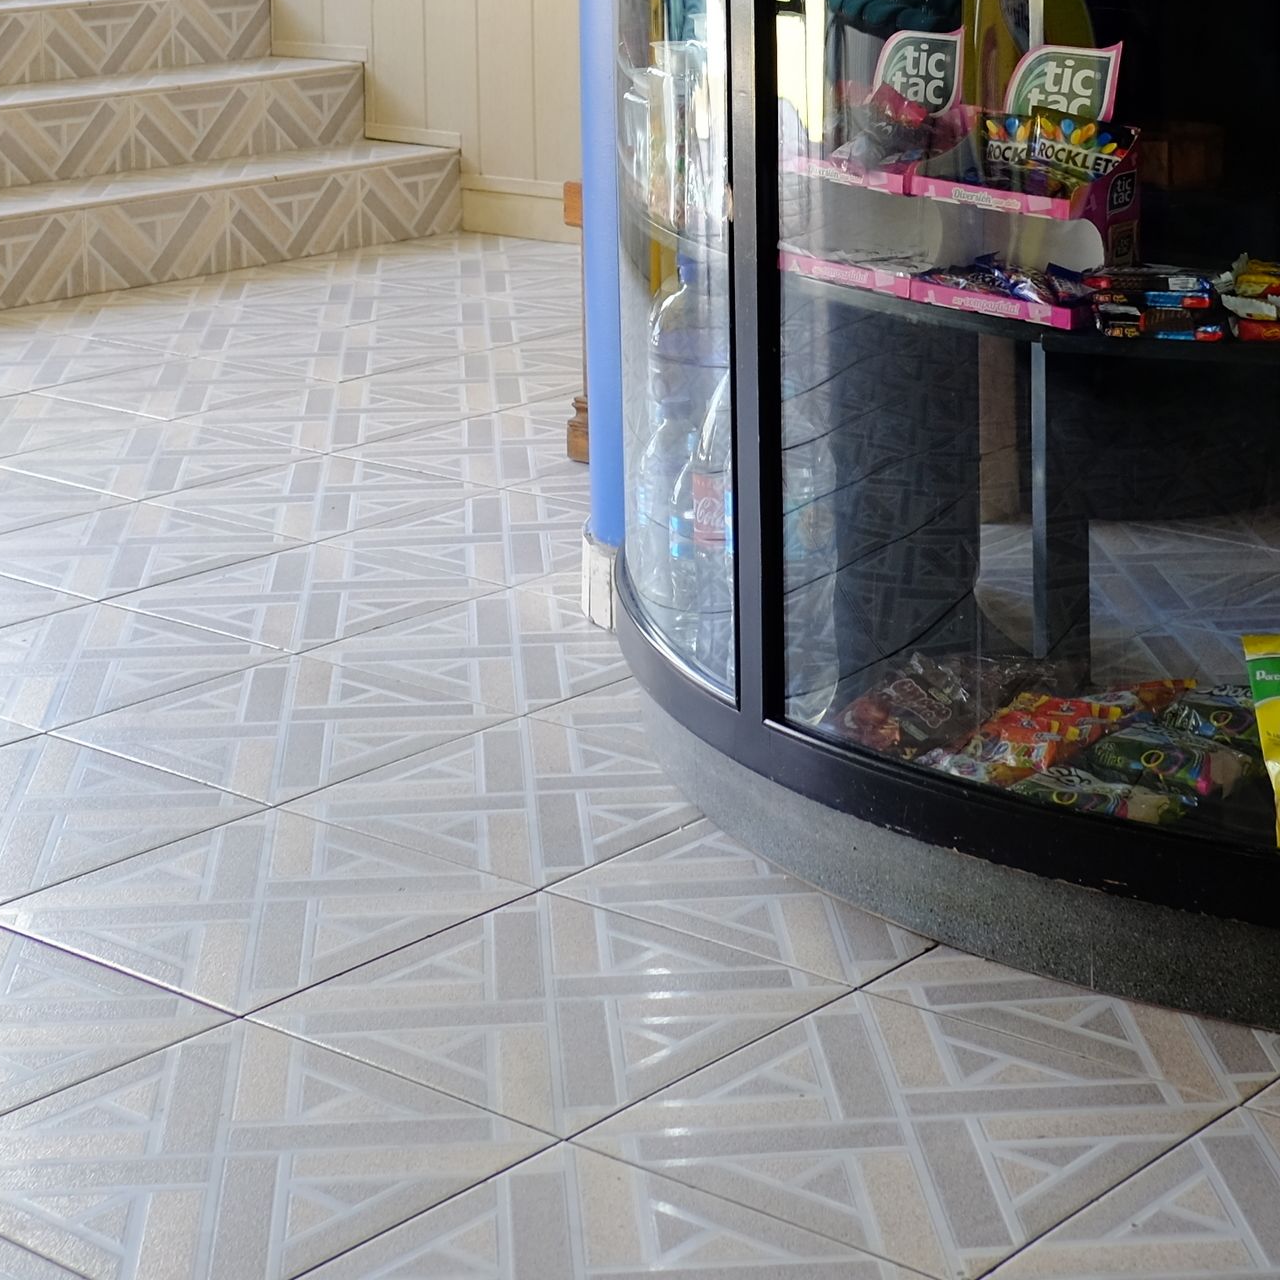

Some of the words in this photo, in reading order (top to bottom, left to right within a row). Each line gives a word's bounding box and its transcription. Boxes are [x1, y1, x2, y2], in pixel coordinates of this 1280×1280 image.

[904, 43, 946, 79] tic
[892, 70, 945, 105] tac
[1044, 59, 1095, 97] tic
[1027, 87, 1091, 116] tac
[1113, 190, 1131, 206] tac
[1116, 176, 1131, 192] tic
